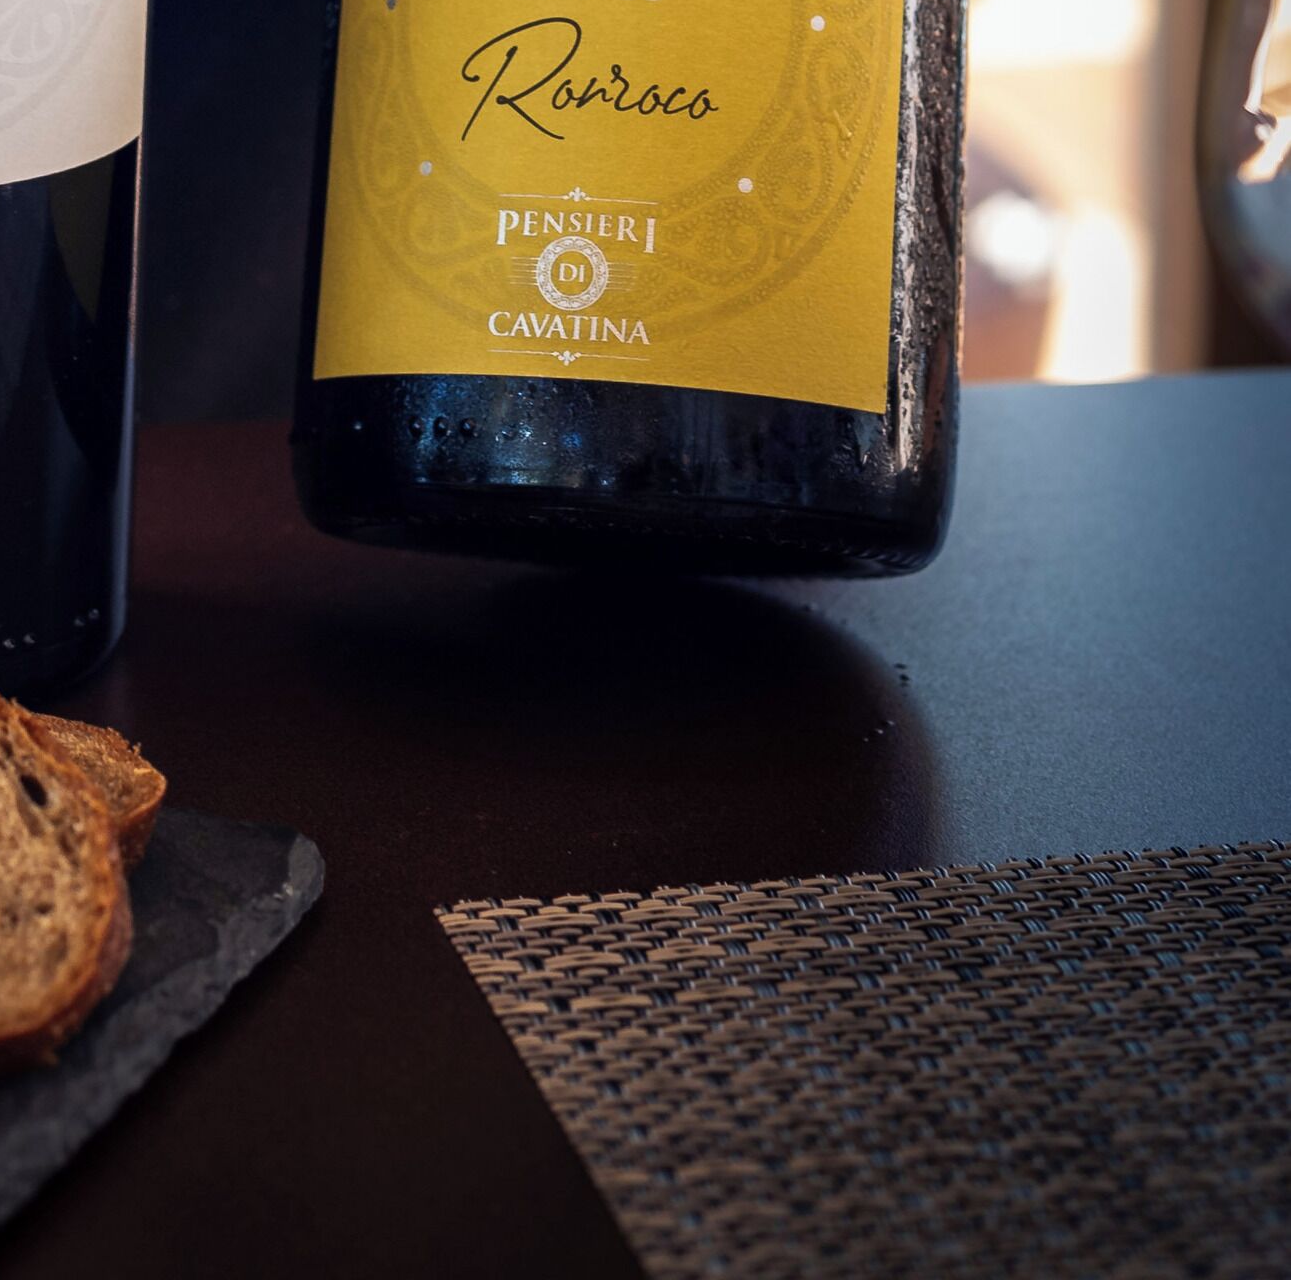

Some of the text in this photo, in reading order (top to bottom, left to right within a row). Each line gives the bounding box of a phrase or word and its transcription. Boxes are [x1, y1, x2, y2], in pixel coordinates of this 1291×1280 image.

[461, 16, 719, 142] Ronroco
[496, 208, 657, 254] PENSIERI
[559, 263, 586, 283] DI
[487, 310, 651, 345] CAVATINA
